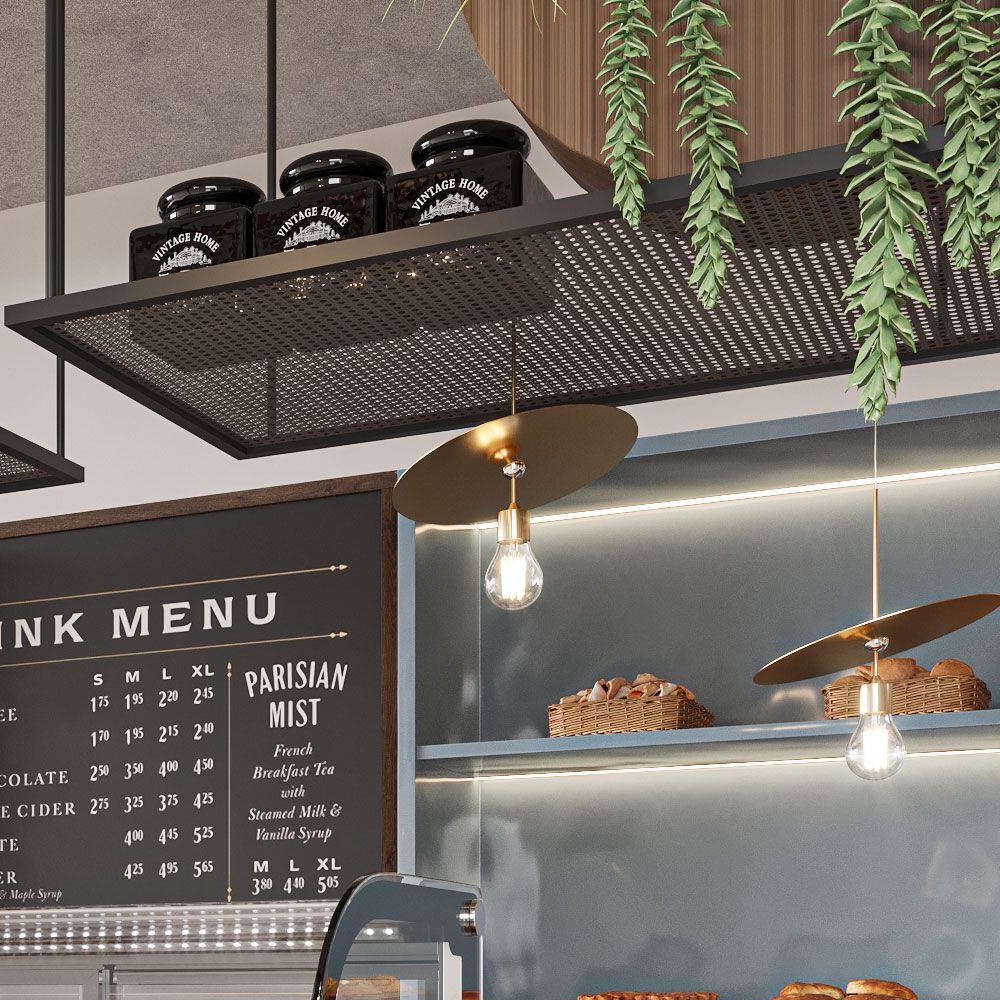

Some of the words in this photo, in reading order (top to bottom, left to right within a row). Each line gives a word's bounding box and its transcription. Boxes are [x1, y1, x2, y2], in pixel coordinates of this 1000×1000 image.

[411, 178, 456, 211] VINTAGE
[458, 178, 489, 200] HOME
[276, 206, 318, 237] VINTAGE
[321, 206, 349, 227] HOME
[152, 232, 191, 263] VINTAGE
[193, 232, 220, 253] HOME
[112, 592, 277, 639] MENU
[93, 673, 103, 686] S
[125, 670, 140, 683] M
[162, 668, 172, 680] L
[191, 664, 214, 679] XL
[245, 660, 348, 698] PARISIAN
[269, 698, 321, 728] MIST
[273, 742, 313, 757] French
[252, 765, 309, 783] Breakfast
[313, 763, 335, 777] Tea
[281, 784, 305, 799] with
[17, 801, 76, 818] CIDER
[248, 804, 294, 821] Steamed
[298, 803, 326, 819] Milk
[330, 803, 342, 817] &
[256, 827, 296, 841] Vanilla
[298, 826, 332, 843] Syrup
[253, 860, 269, 872] M
[289, 859, 300, 872] L
[316, 857, 342, 871] XL
[9, 889, 36, 902] Maple
[37, 888, 62, 902] Syrup
